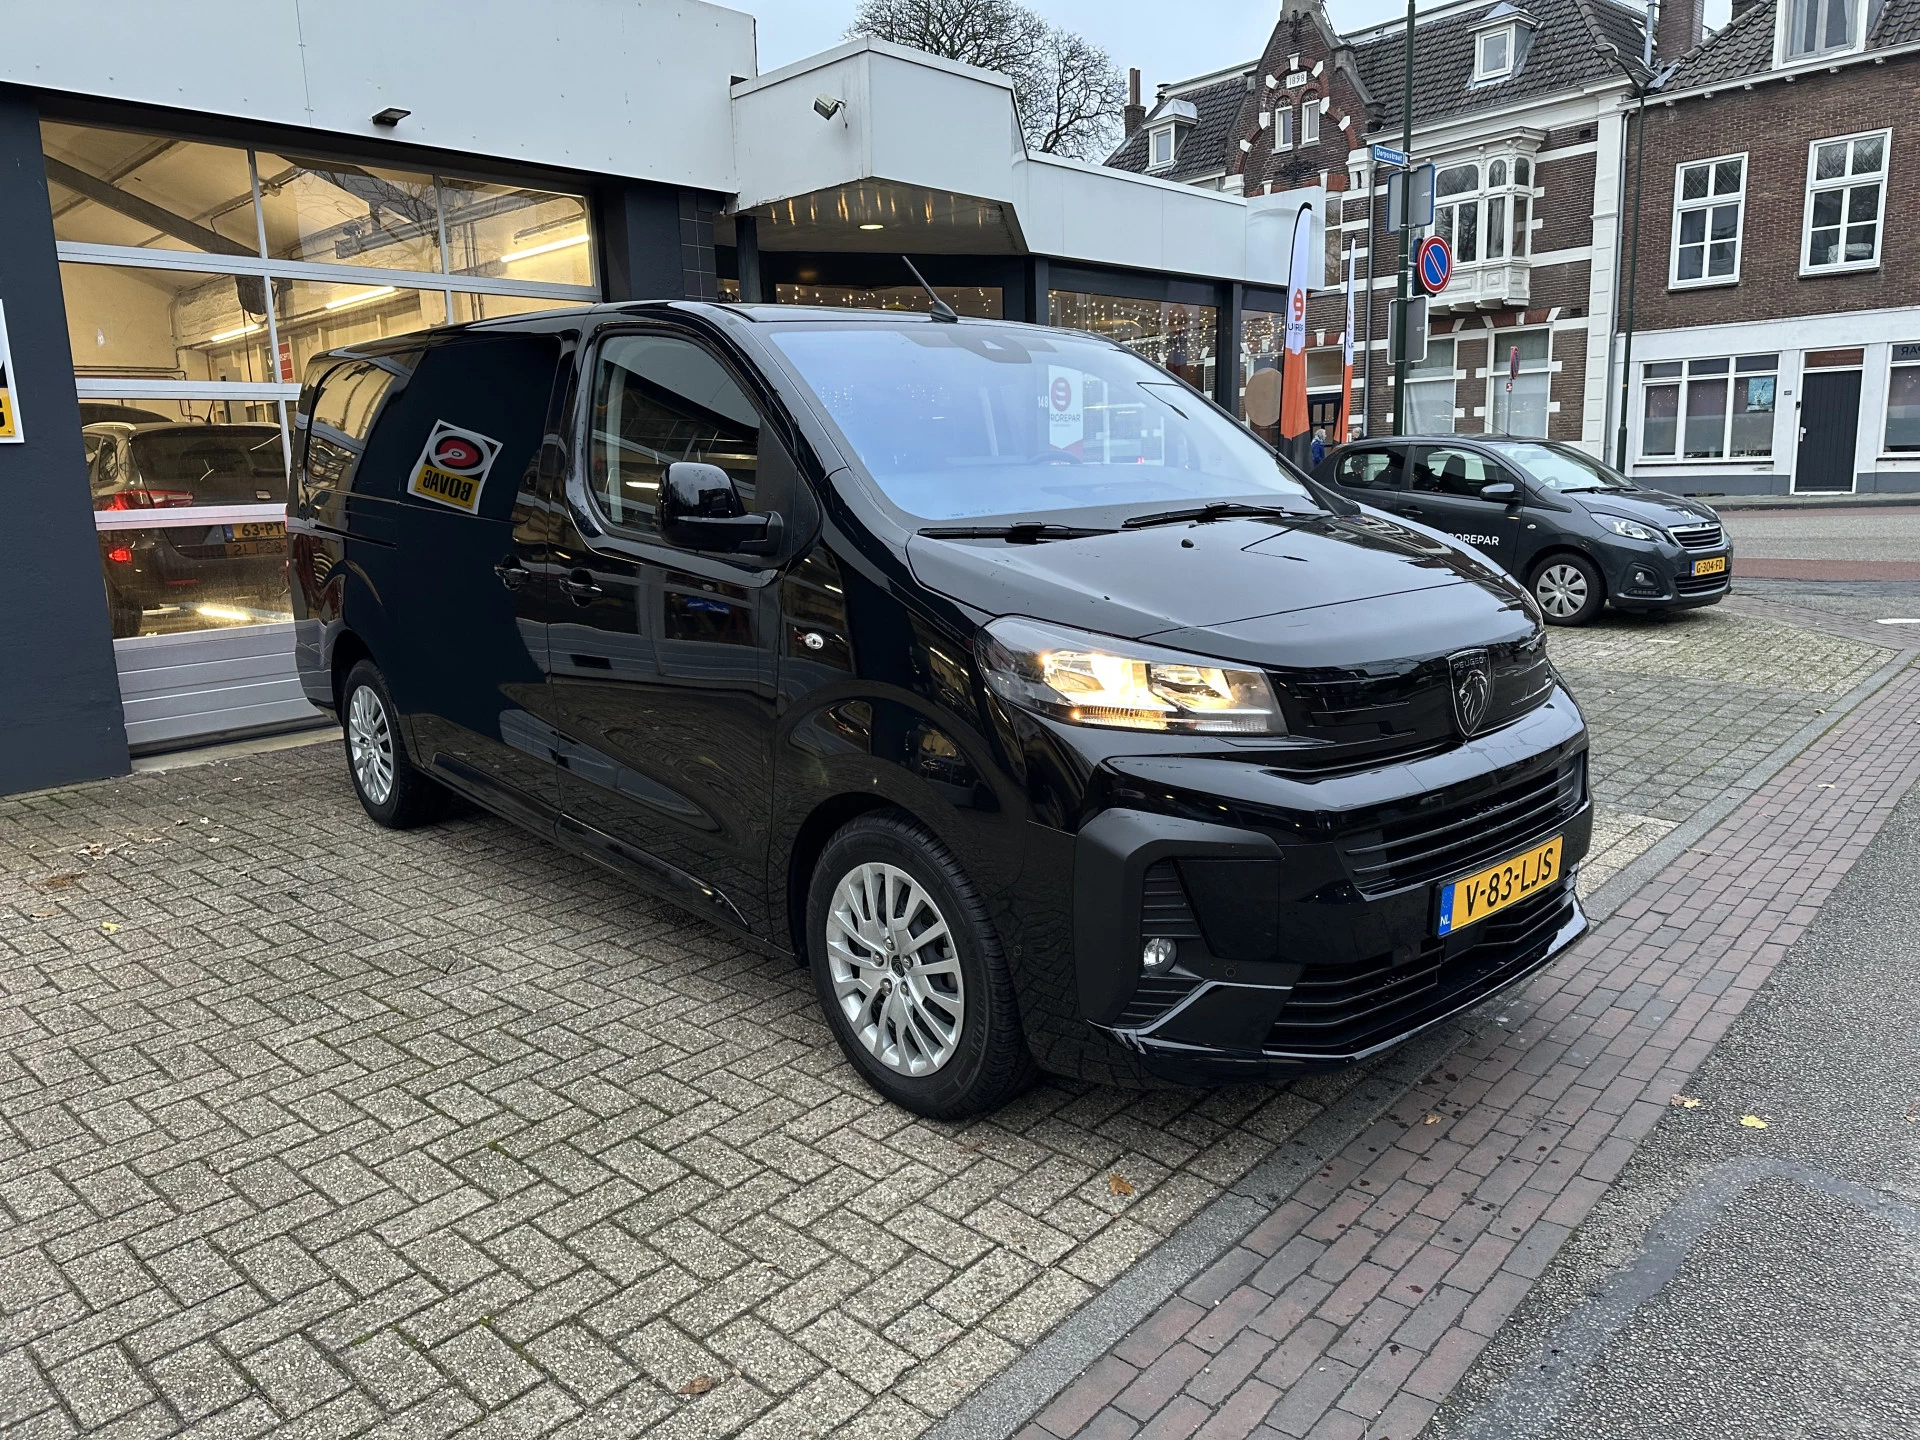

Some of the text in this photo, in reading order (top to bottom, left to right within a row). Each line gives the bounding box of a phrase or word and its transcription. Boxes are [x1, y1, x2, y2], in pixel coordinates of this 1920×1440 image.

[1289, 74, 1305, 85] 1898
[1376, 148, 1403, 162] Dorpsstraat
[1448, 533, 1500, 546] OREPAR
[1696, 559, 1723, 573] G-304-FD
[1453, 656, 1487, 670] PEUGEOT
[1466, 847, 1554, 917] V-83-LJS
[1440, 914, 1450, 926] NL
